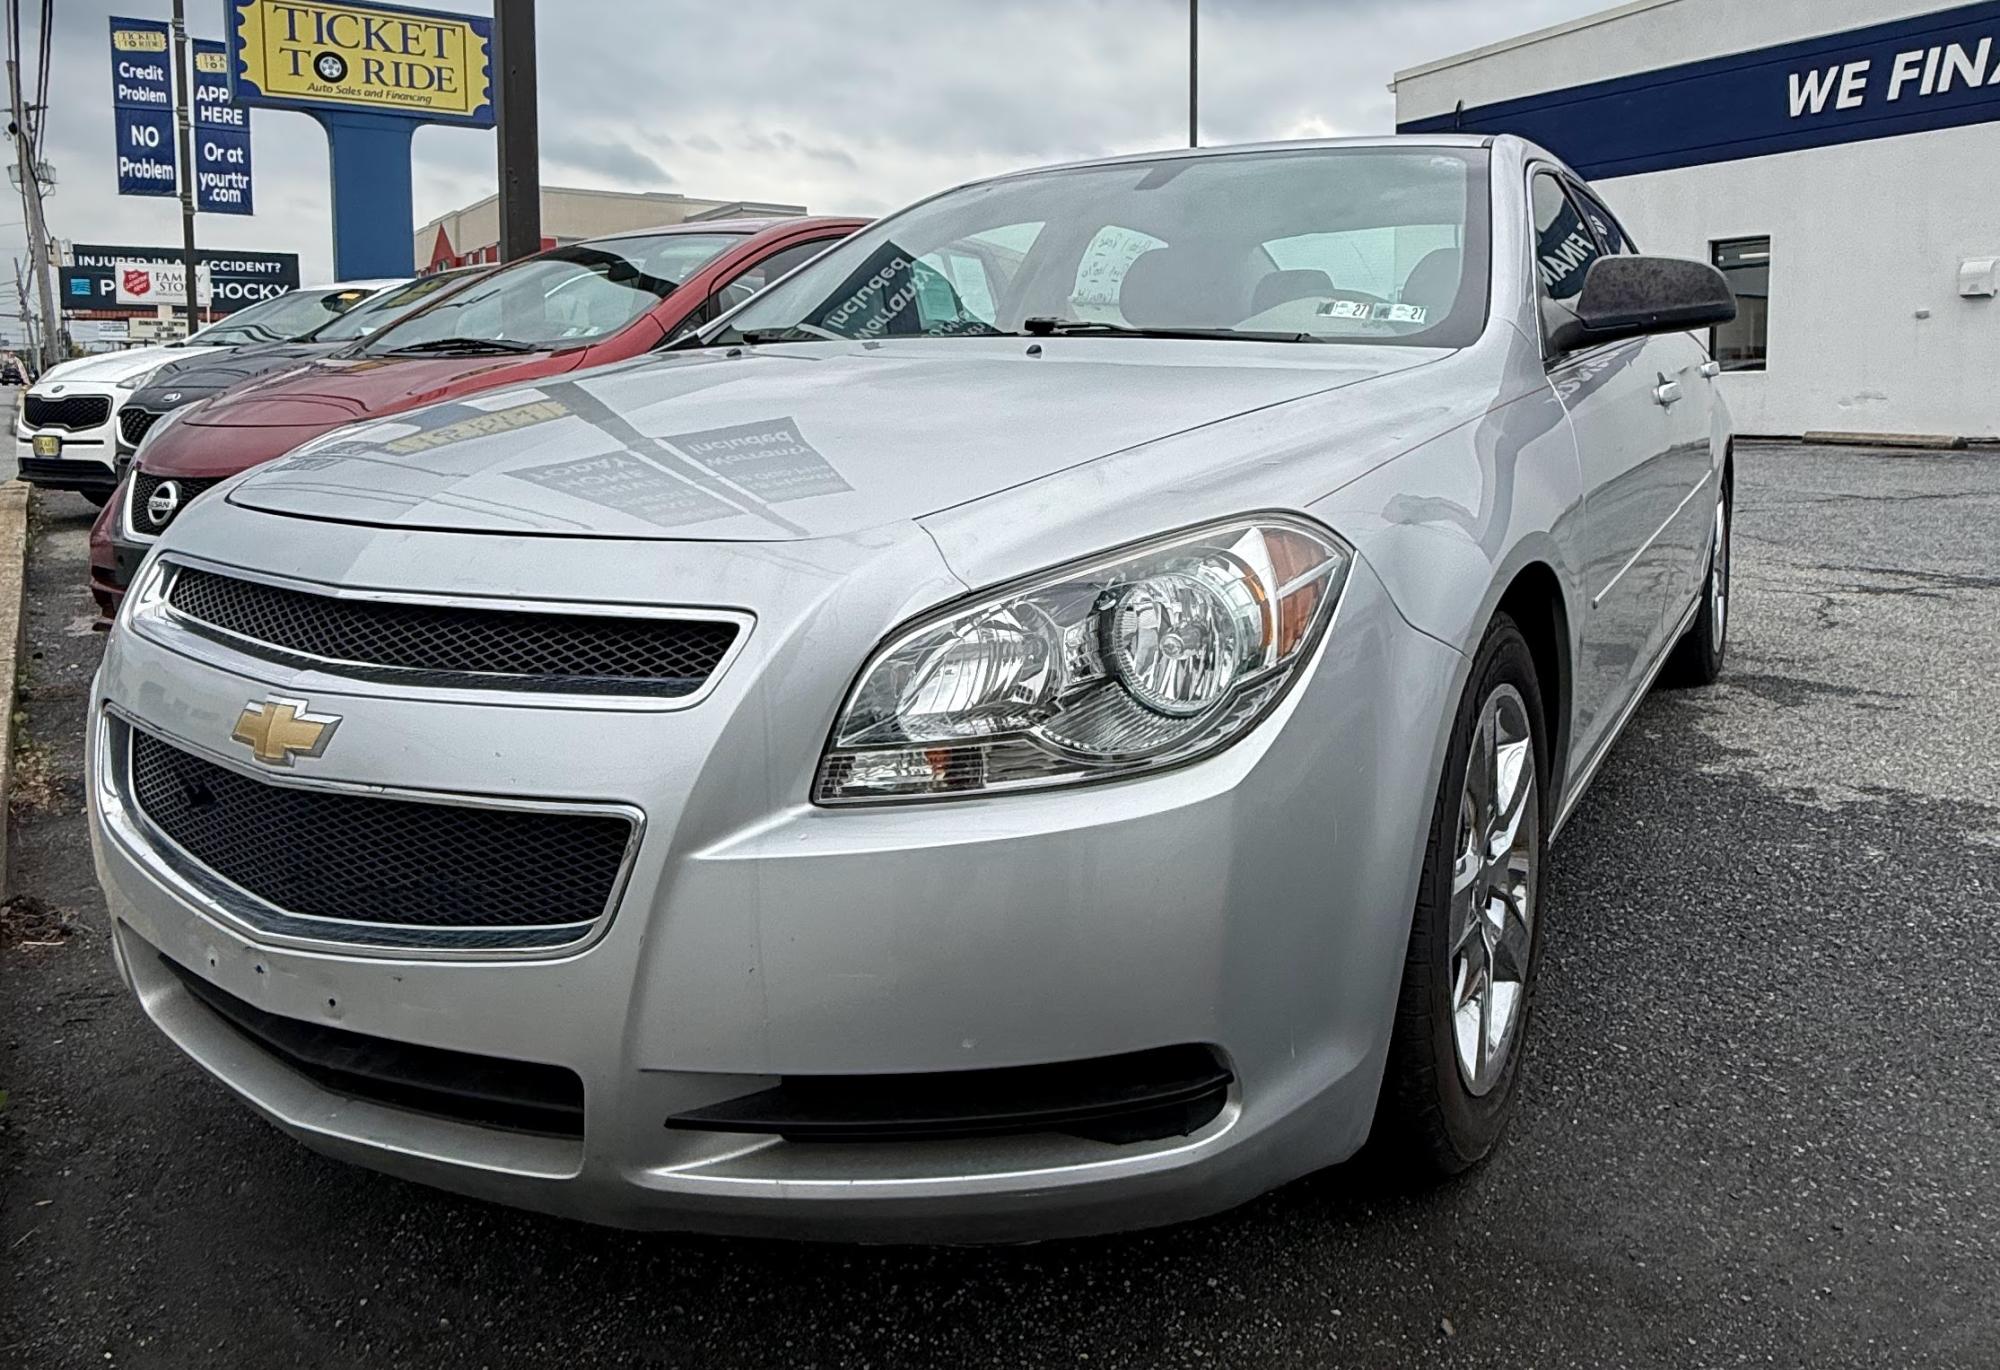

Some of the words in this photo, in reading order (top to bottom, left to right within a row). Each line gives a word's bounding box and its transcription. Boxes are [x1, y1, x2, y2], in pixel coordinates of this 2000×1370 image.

[121, 32, 158, 40] TICKET
[273, 5, 456, 59] TICKET
[119, 62, 164, 81] Credit
[361, 57, 457, 93] RIDE
[118, 84, 167, 103] Problem
[196, 85, 229, 103] APP
[307, 82, 333, 94] Auto
[336, 86, 361, 96] Sales
[364, 90, 383, 98] and
[386, 91, 432, 105] Financing
[1789, 60, 1870, 118] WE
[200, 105, 243, 125] HERE
[131, 125, 159, 147] NO
[204, 142, 224, 161] Or
[227, 147, 244, 164] at
[120, 156, 173, 180] Problem
[199, 172, 249, 191] yourttr
[209, 188, 241, 203] .com
[155, 272, 203, 282] FAMY
[160, 282, 184, 292] STO
[210, 282, 289, 300] HOCKY
[1352, 303, 1367, 316] 27
[1410, 307, 1424, 320] 27
